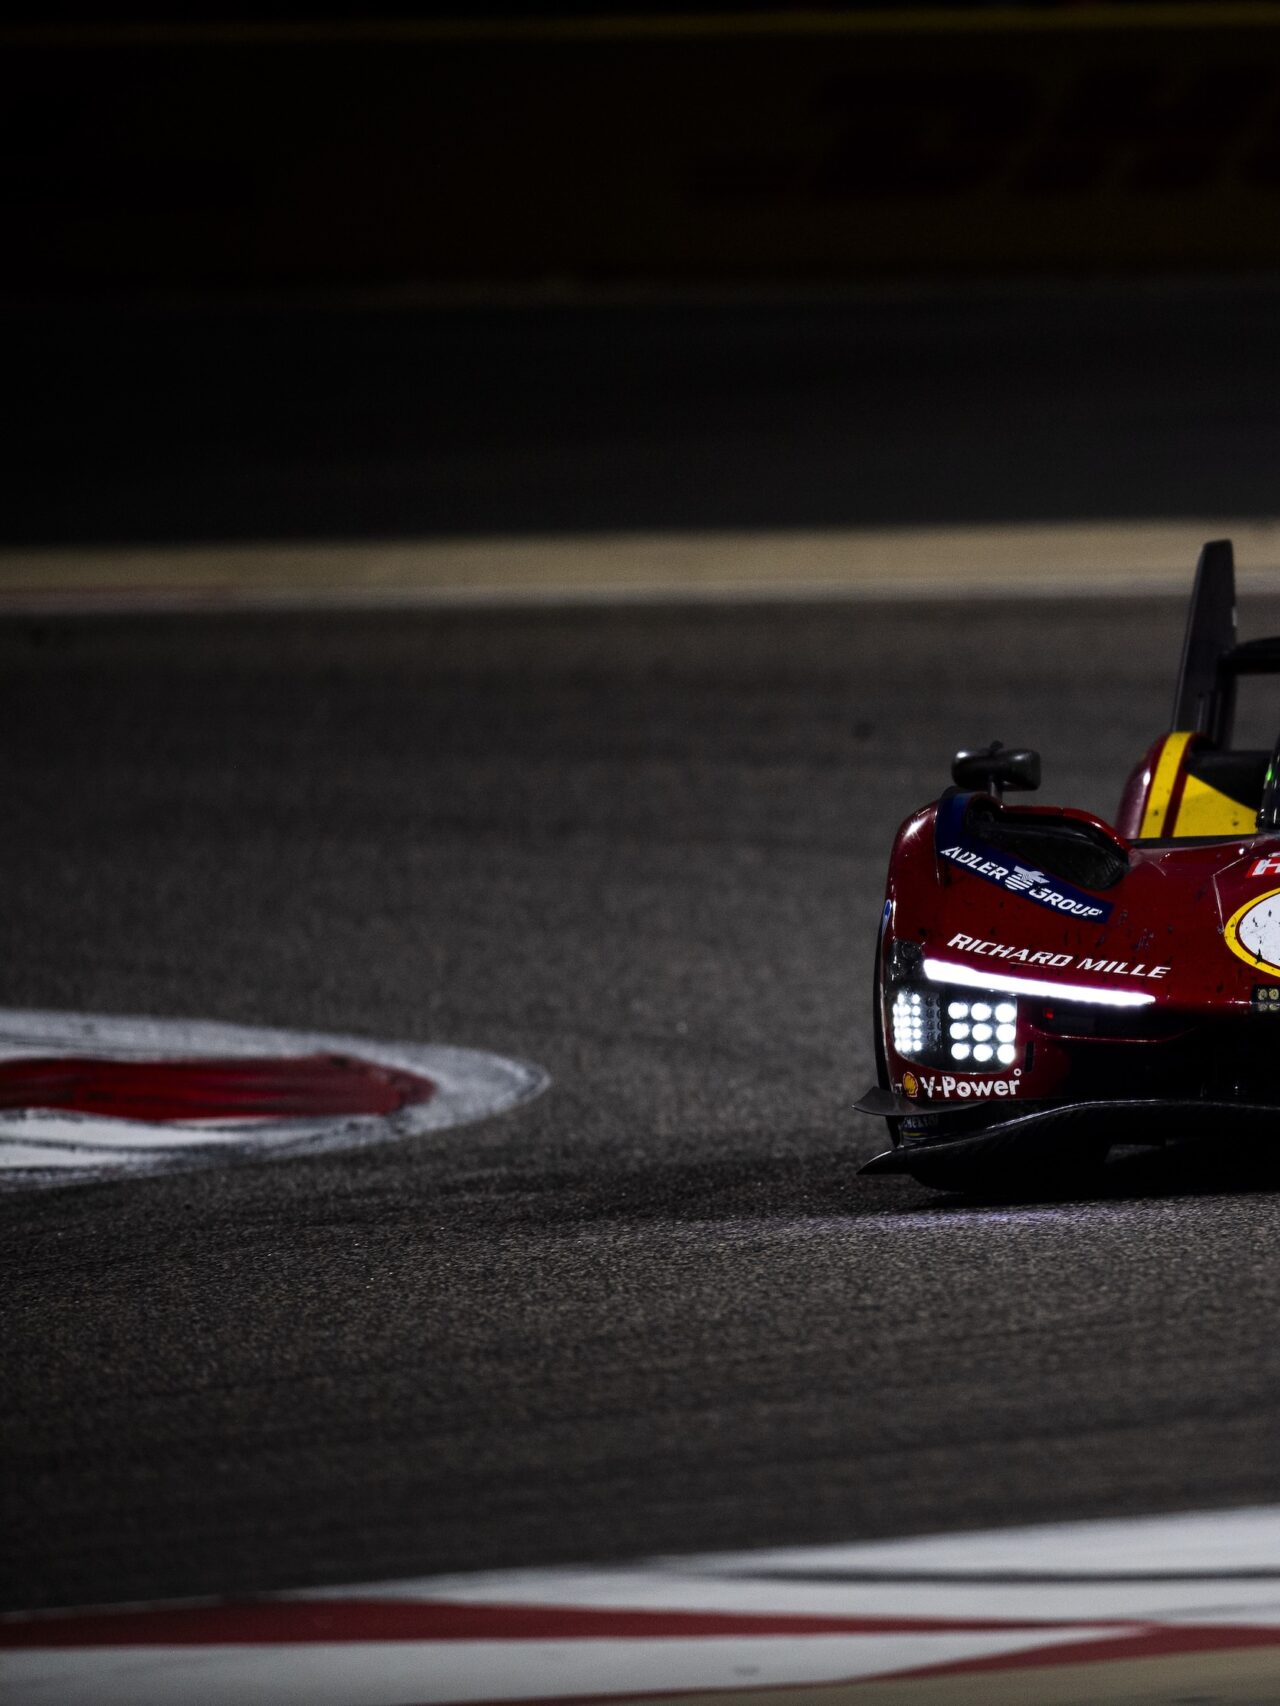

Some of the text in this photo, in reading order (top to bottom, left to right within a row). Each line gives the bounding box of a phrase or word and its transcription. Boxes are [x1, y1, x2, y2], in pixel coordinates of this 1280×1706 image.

[940, 846, 1104, 918] ADLER GROUP
[946, 932, 1172, 979] RICHARD MILLE
[919, 1075, 1021, 1099] V-Power
